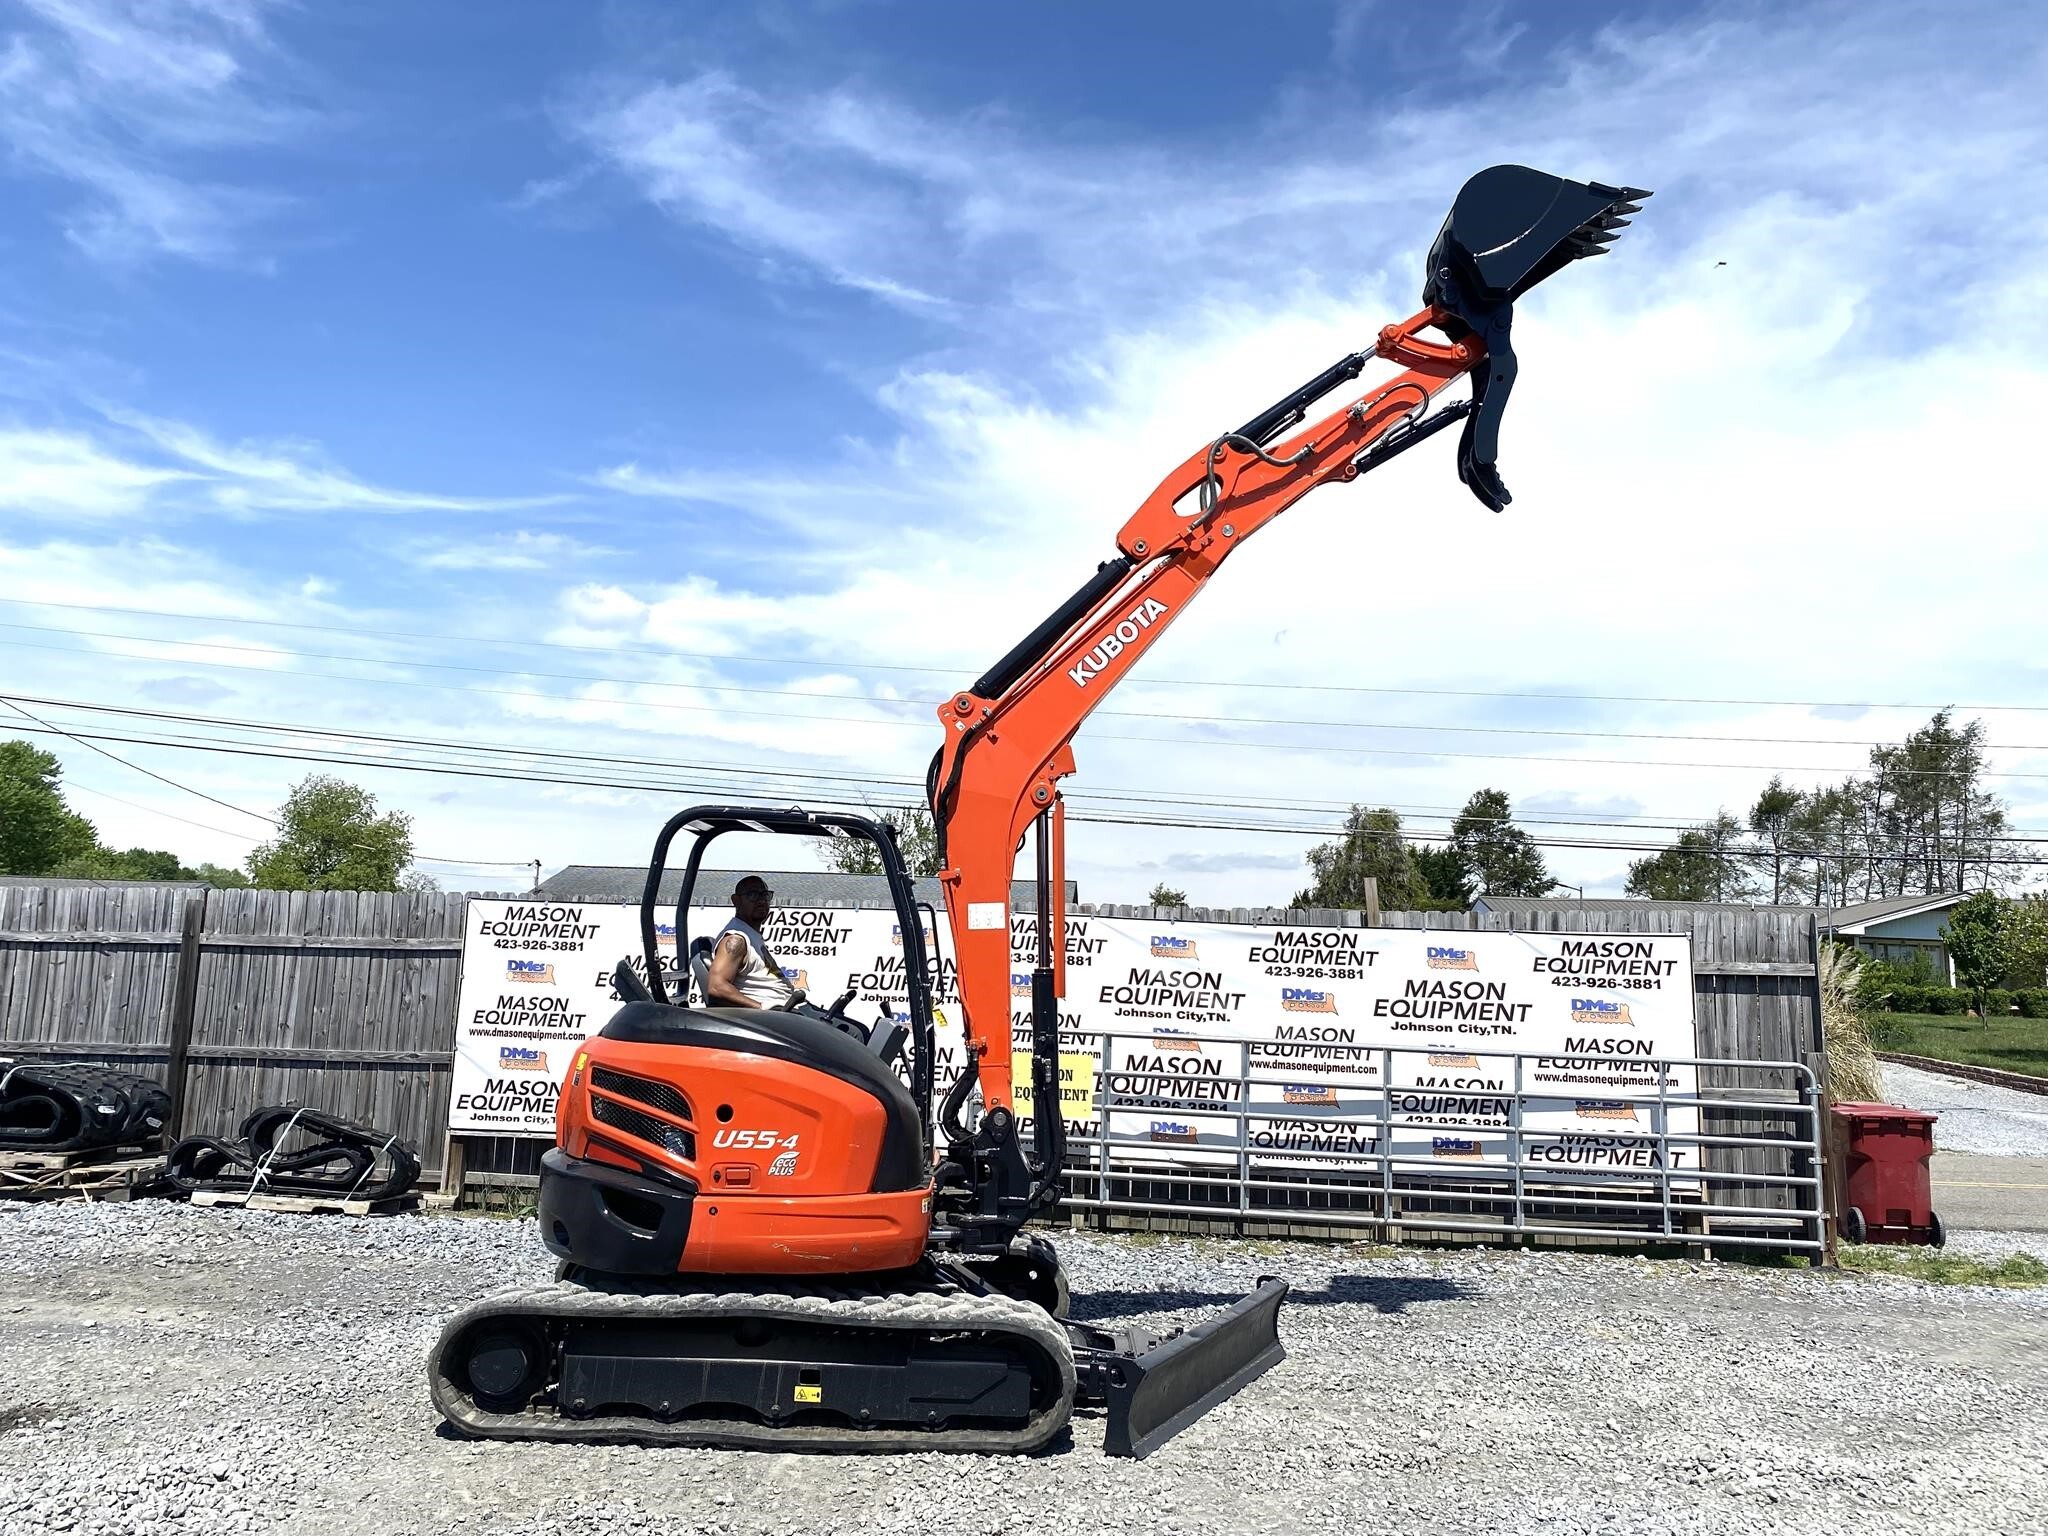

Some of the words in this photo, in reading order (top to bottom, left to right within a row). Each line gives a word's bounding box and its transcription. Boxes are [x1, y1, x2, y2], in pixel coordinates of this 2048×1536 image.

[1068, 597, 1169, 688] KUBOTA
[505, 906, 582, 922] MASON
[480, 921, 600, 939] EQUIPMENT
[760, 927, 852, 943] UIPMENT
[1011, 919, 1087, 936] MAN
[494, 939, 584, 951] 423-926-3881
[1274, 931, 1358, 949] MASON
[767, 945, 837, 956] -926-3881
[1249, 947, 1379, 967] EQUIPMENT
[1560, 941, 1653, 958] MASON
[874, 956, 957, 973] MAON
[1264, 965, 1364, 980] 423-926-3881
[1533, 957, 1677, 976] EQUIPMENT
[1128, 968, 1222, 990] MASON
[1552, 976, 1662, 990] 423-926-3881
[1099, 986, 1246, 1010] EQUIPMENT
[1404, 979, 1506, 1001] MASON
[497, 995, 569, 1011] MASON
[1373, 998, 1533, 1023] EQUIPMENT
[473, 1010, 586, 1028] EQUIPMENT
[1115, 1007, 1172, 1019] Johnson
[1176, 1011, 1231, 1022] City,TN.
[469, 1027, 586, 1041] www.dmasonequipment.com
[1275, 1025, 1356, 1043] MASON
[1391, 1021, 1453, 1032] Johnson
[1458, 1024, 1517, 1036] City,TN.
[1564, 1037, 1654, 1055] MASON
[1126, 1054, 1222, 1076] MASON
[484, 1079, 563, 1096] MASON
[456, 1094, 559, 1113] EQUIPME
[470, 1113, 520, 1122] Johnson
[524, 1115, 556, 1125] City,T
[713, 1130, 799, 1149] U55-4
[768, 1167, 795, 1176] PLUS
[776, 1159, 797, 1167] eco
